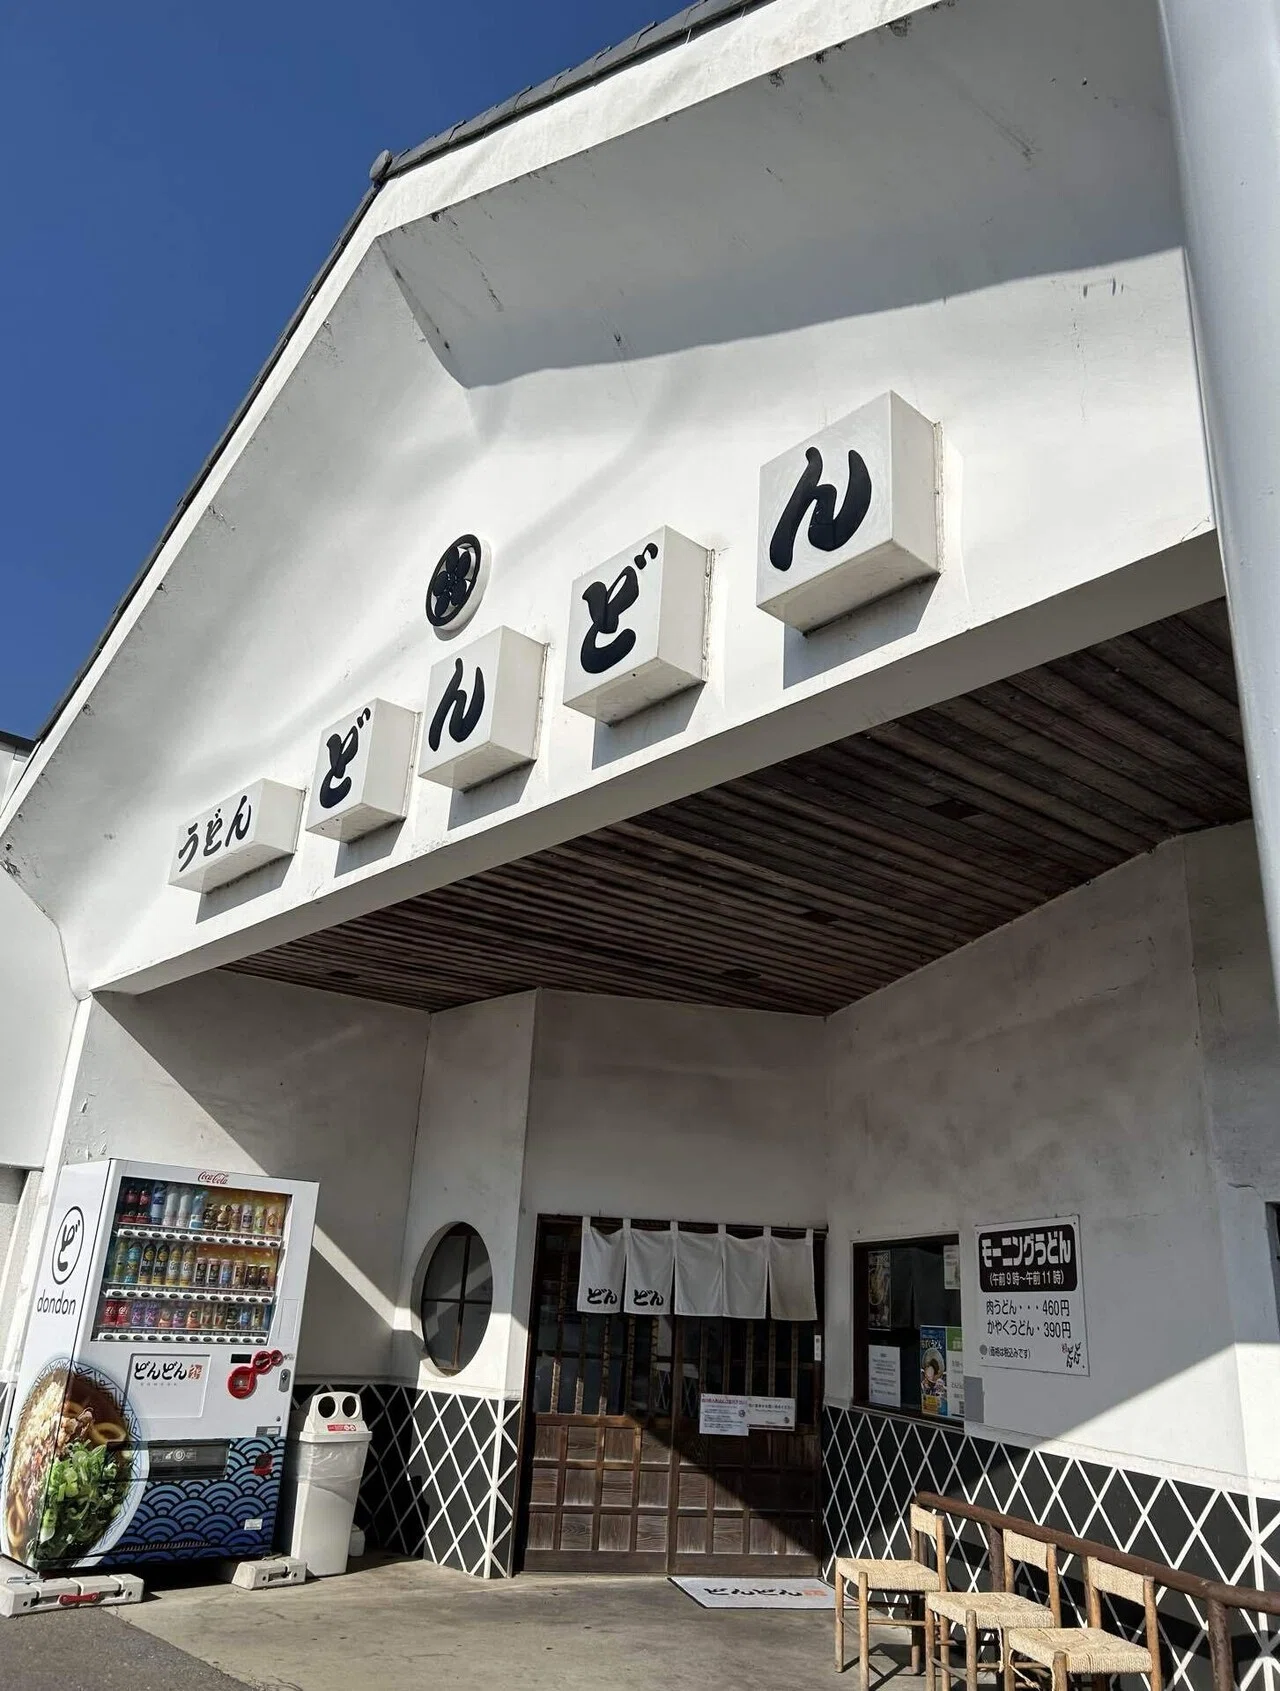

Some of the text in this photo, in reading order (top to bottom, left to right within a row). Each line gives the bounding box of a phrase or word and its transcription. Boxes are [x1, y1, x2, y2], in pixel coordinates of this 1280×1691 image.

[178, 795, 251, 872] うどん
[57, 1219, 81, 1272] ど
[982, 1231, 1071, 1267] モーニングうどん
[37, 1289, 77, 1315] dondon
[134, 1361, 187, 1381] どんどん
